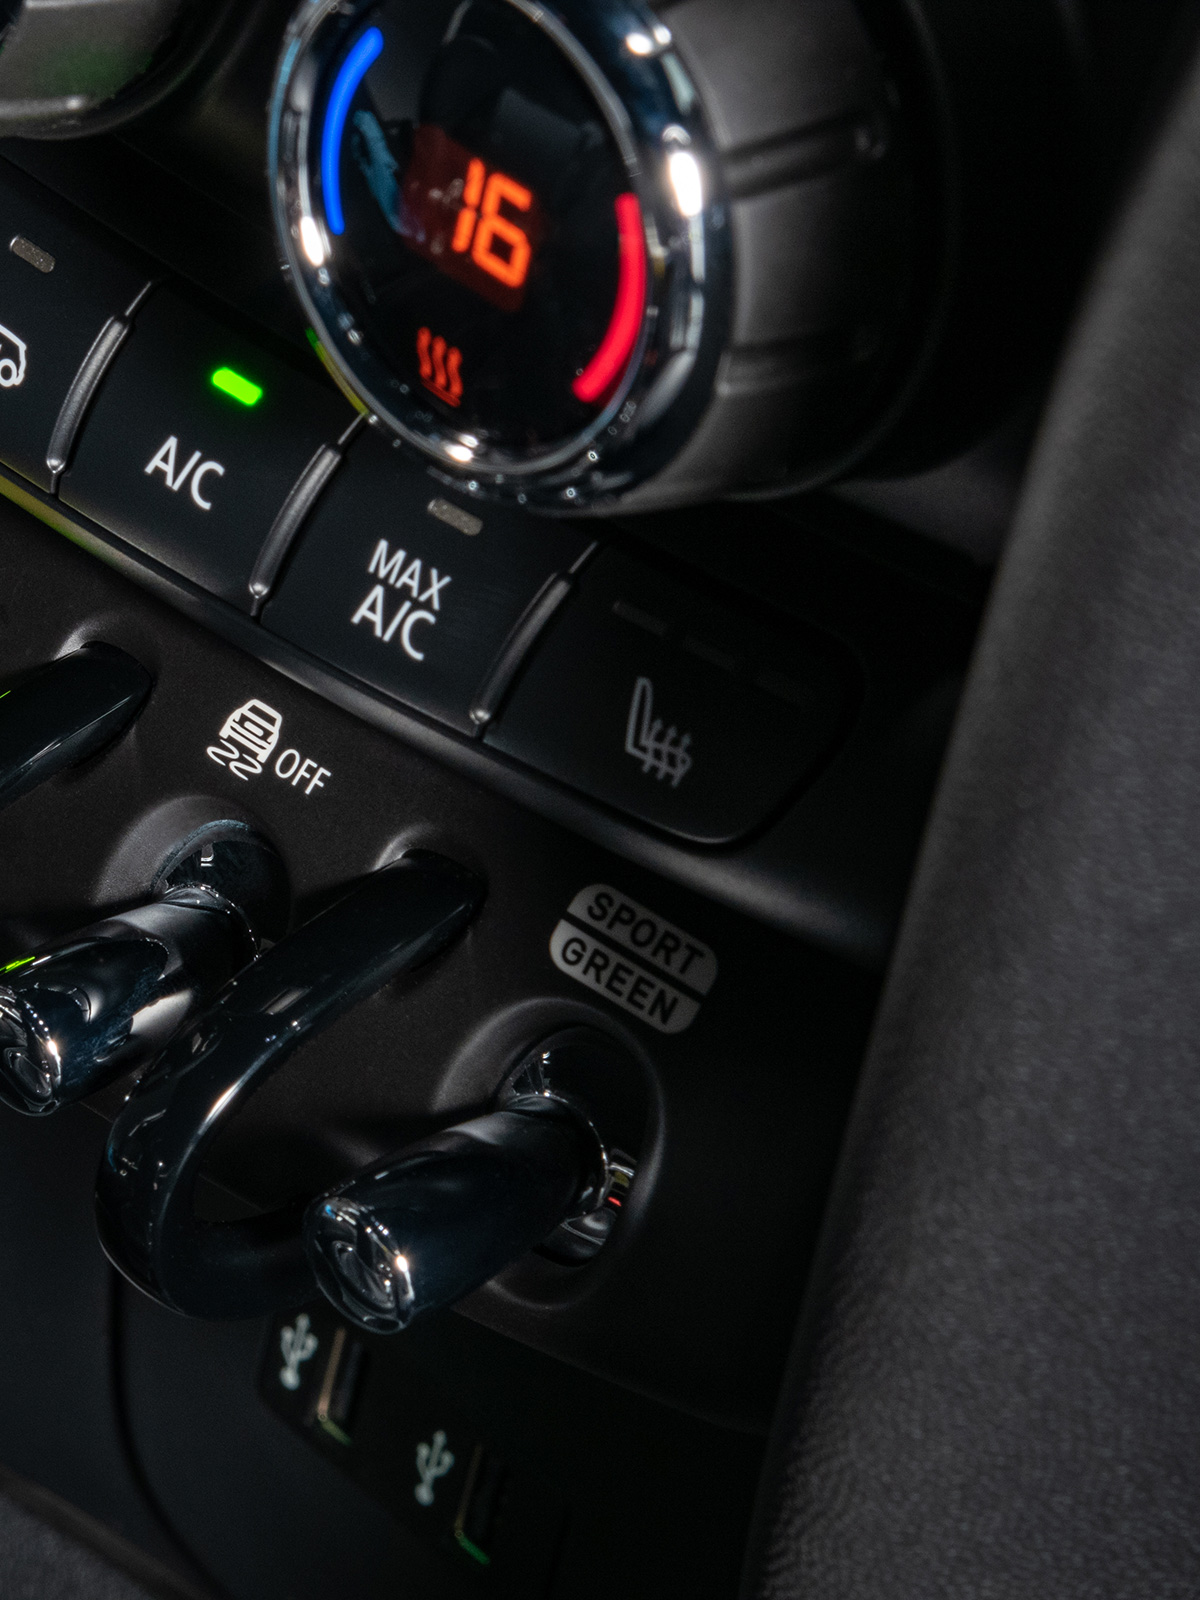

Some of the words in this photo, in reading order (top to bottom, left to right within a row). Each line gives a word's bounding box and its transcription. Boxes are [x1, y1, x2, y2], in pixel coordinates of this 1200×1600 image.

[451, 157, 532, 287] 16
[144, 436, 225, 510] A/C
[367, 539, 451, 610] MAX
[351, 585, 436, 661] A/C
[274, 748, 332, 796] OFF
[586, 891, 705, 976] SPORT
[560, 937, 681, 1026] GREEN
